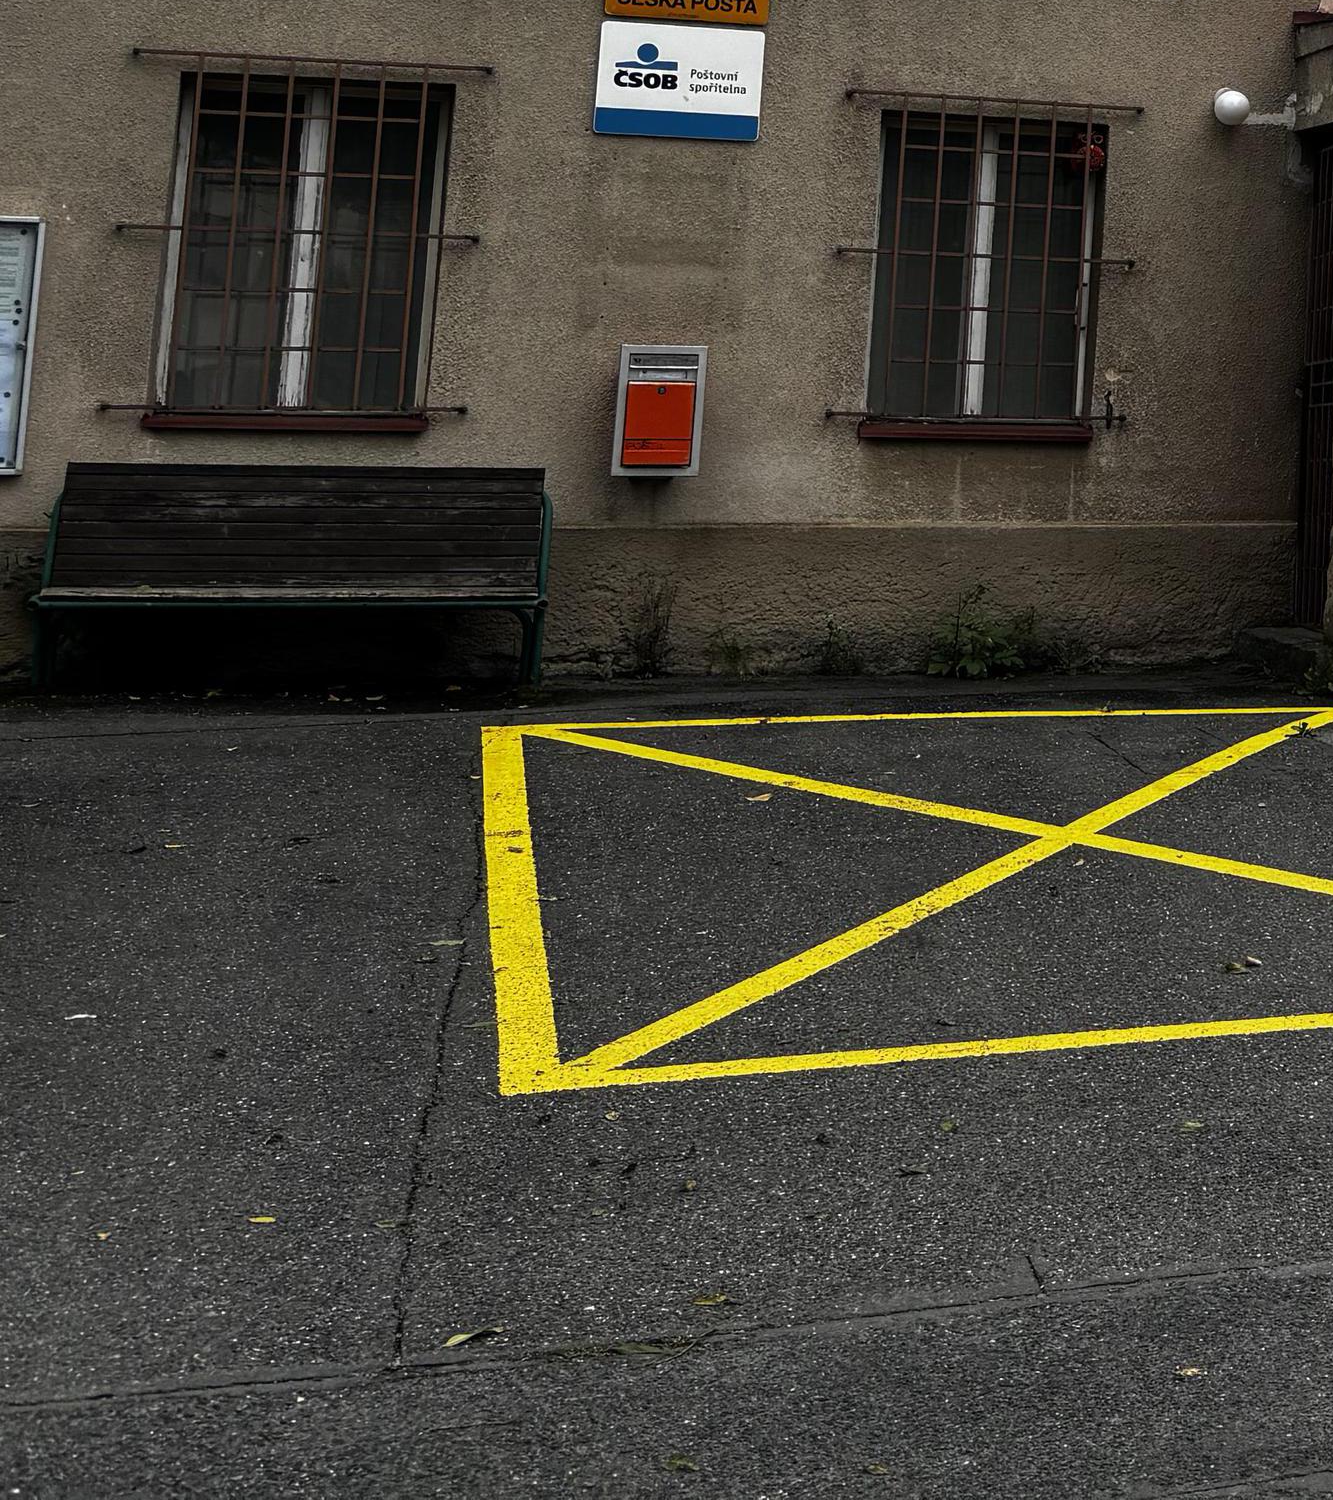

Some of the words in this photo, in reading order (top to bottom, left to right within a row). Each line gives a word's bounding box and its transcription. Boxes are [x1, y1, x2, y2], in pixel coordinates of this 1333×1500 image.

[613, 69, 678, 90] ČSOB
[690, 69, 739, 82] Poštovní
[689, 82, 747, 96] spořitelna
